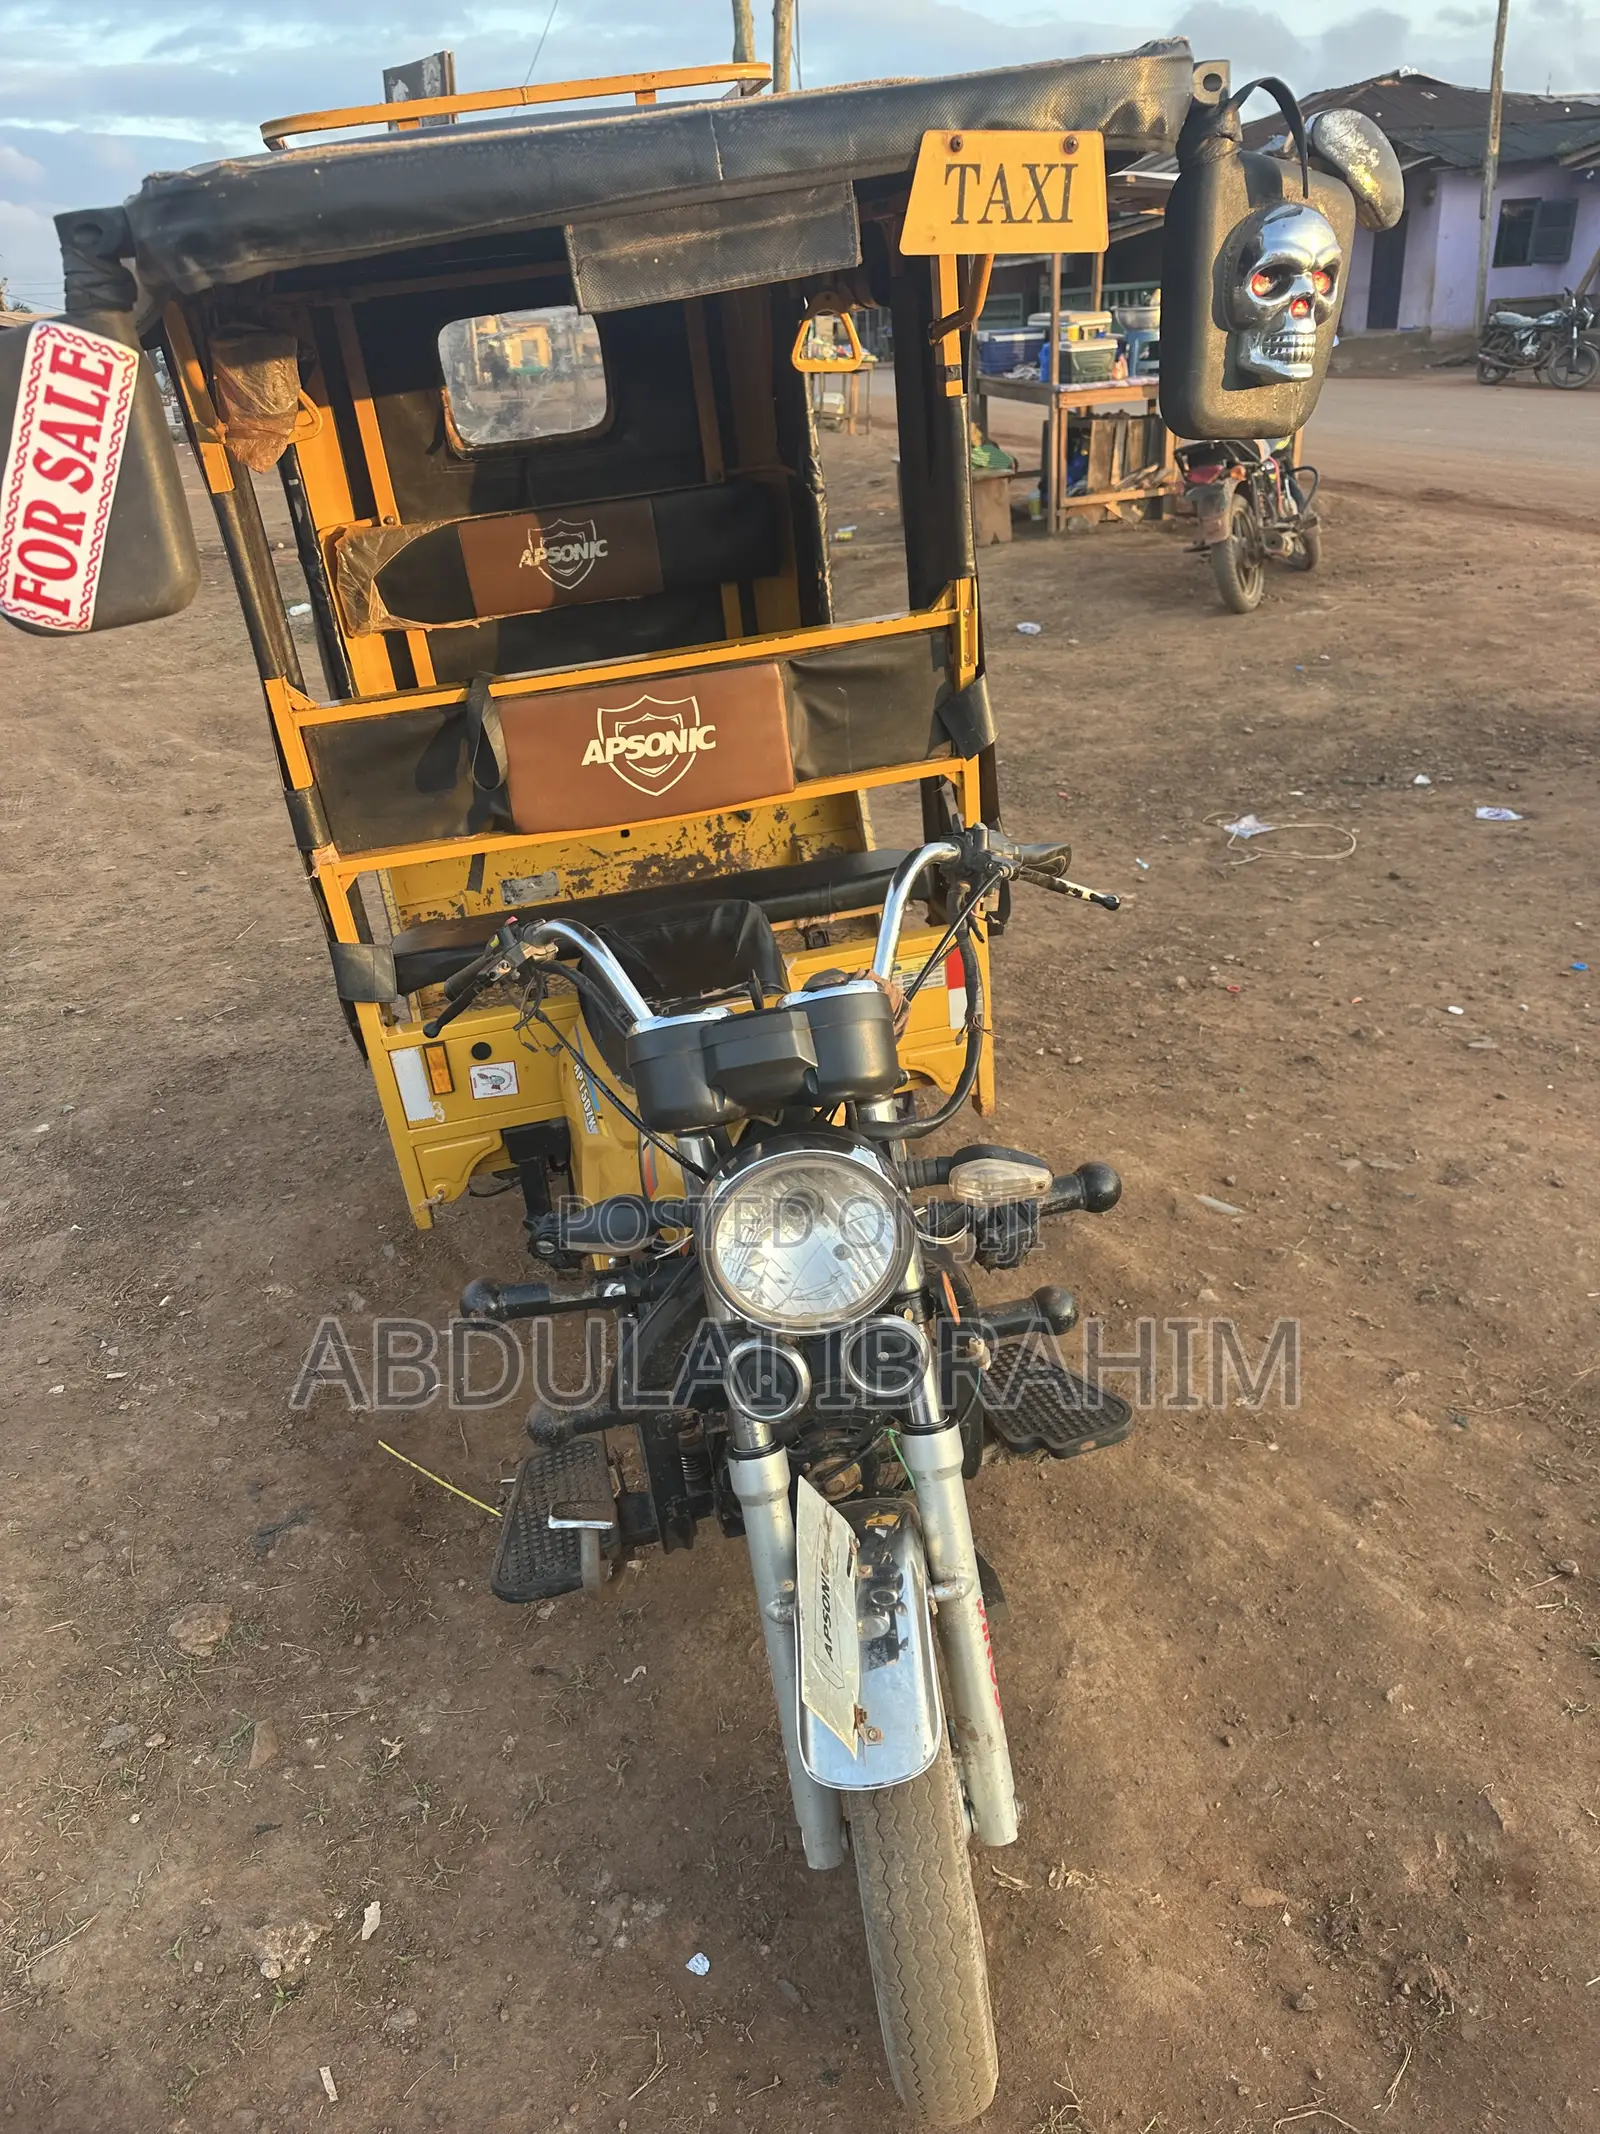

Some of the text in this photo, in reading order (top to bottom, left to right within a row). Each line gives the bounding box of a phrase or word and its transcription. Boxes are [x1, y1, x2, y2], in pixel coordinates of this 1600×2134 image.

[944, 163, 1079, 225] TAXI
[12, 343, 115, 617] FOR SALE
[518, 539, 609, 569] APSONIC
[581, 724, 717, 766] APSONIC
